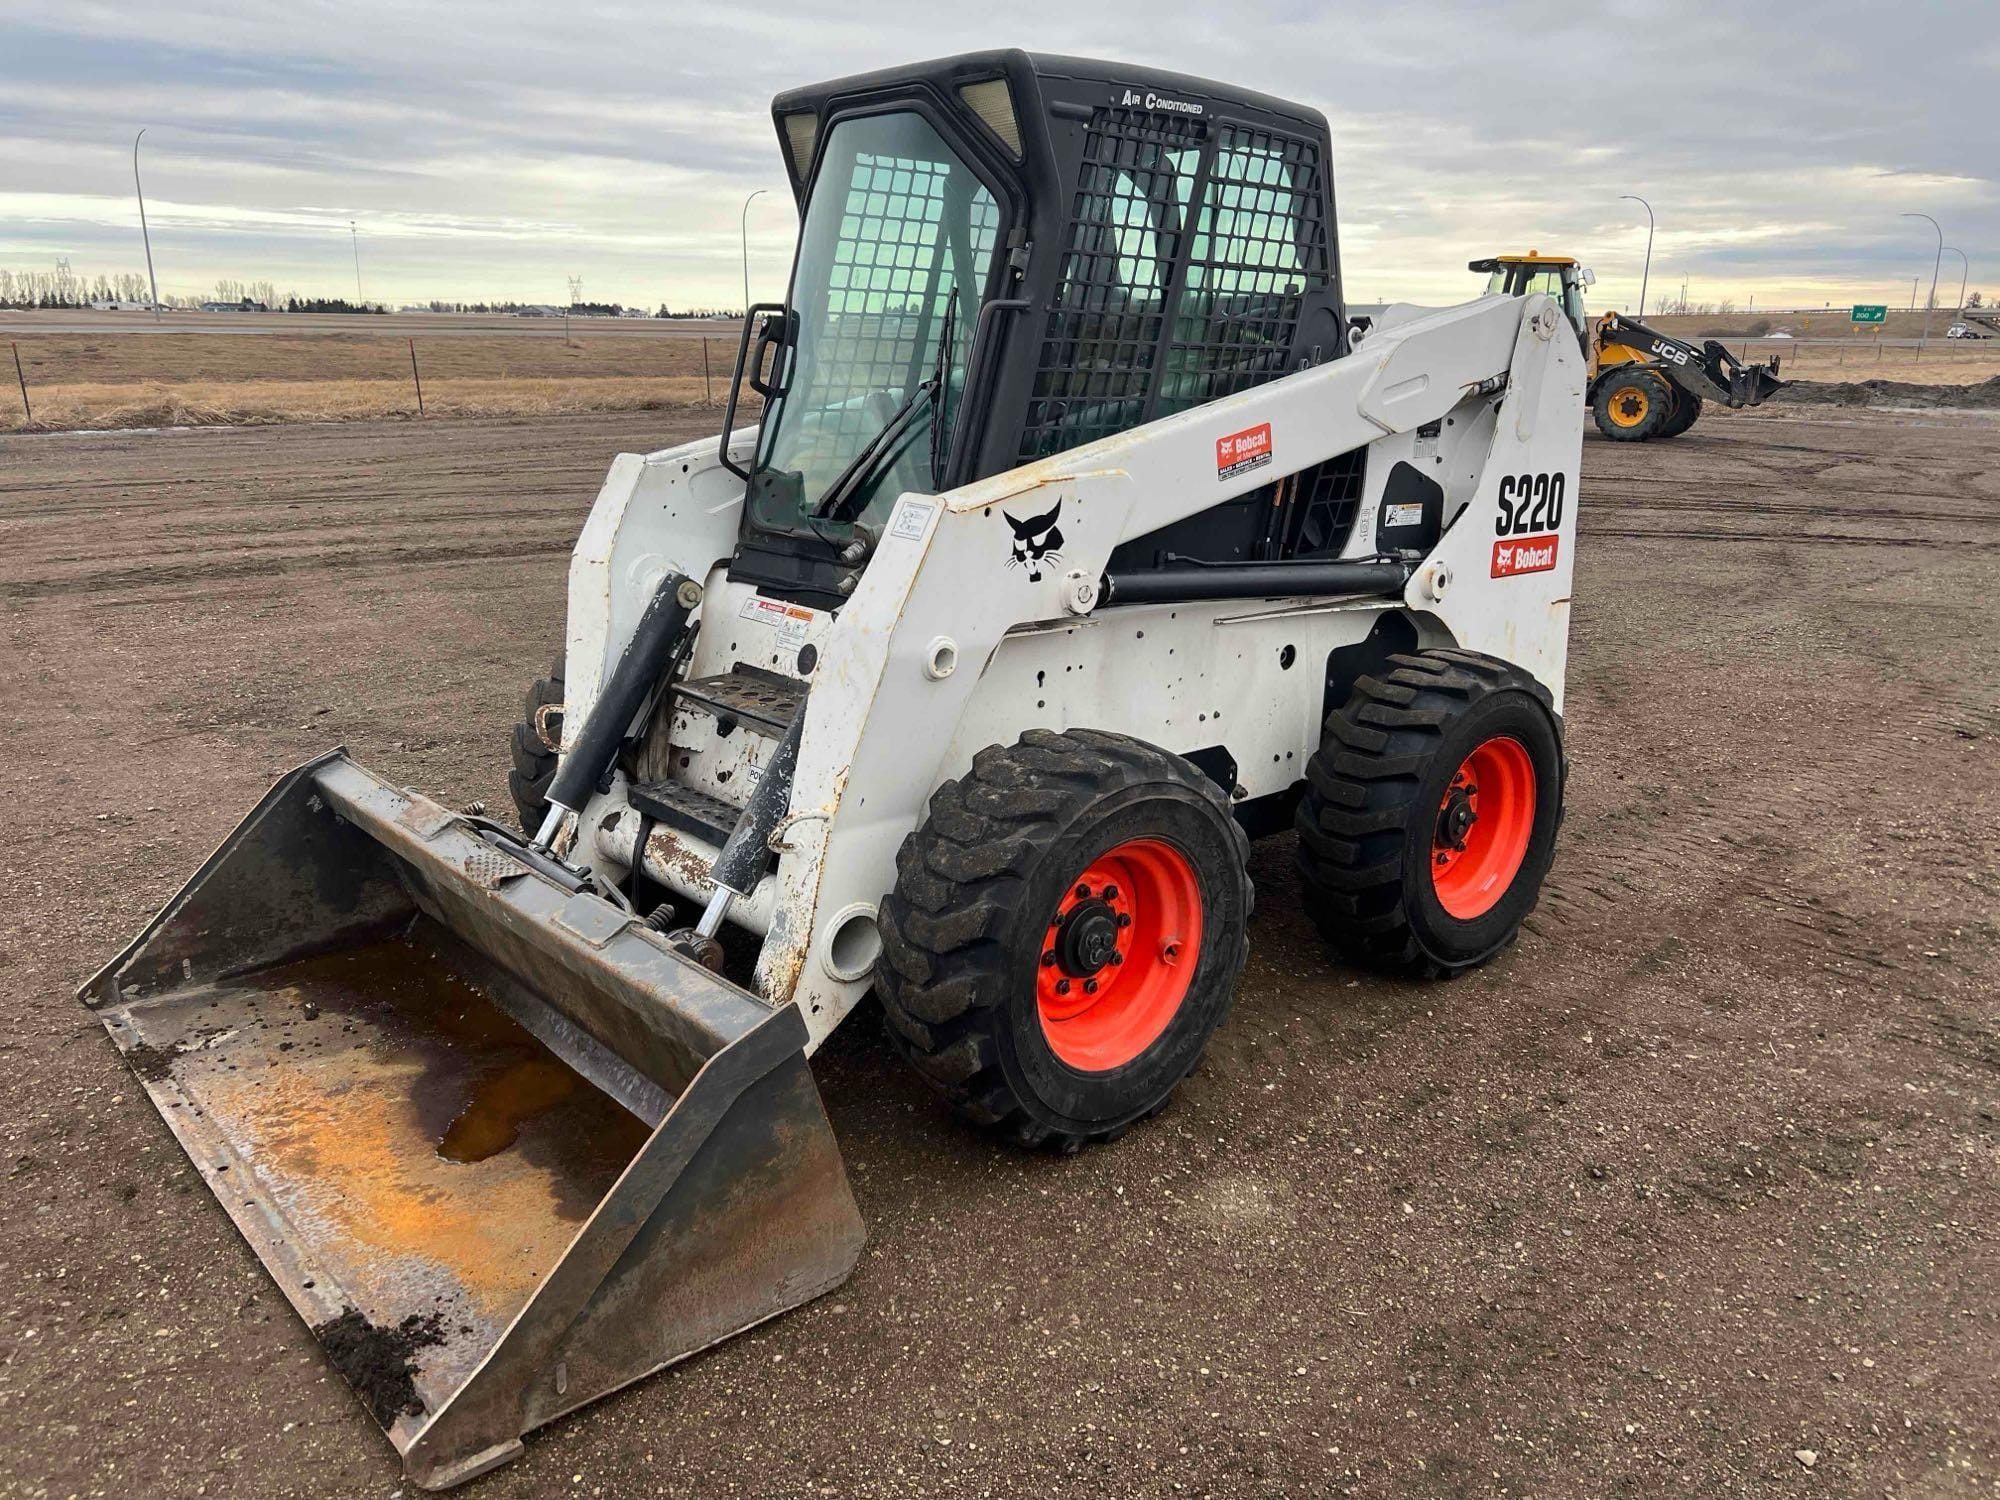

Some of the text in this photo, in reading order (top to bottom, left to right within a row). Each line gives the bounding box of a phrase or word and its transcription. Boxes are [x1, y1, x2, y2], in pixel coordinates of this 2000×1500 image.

[1651, 341, 1689, 366] JCB
[1235, 431, 1266, 453] Bobcat
[1219, 465, 1232, 474] SALES
[1496, 472, 1565, 536] S220
[1514, 545, 1553, 570] Bobcat
